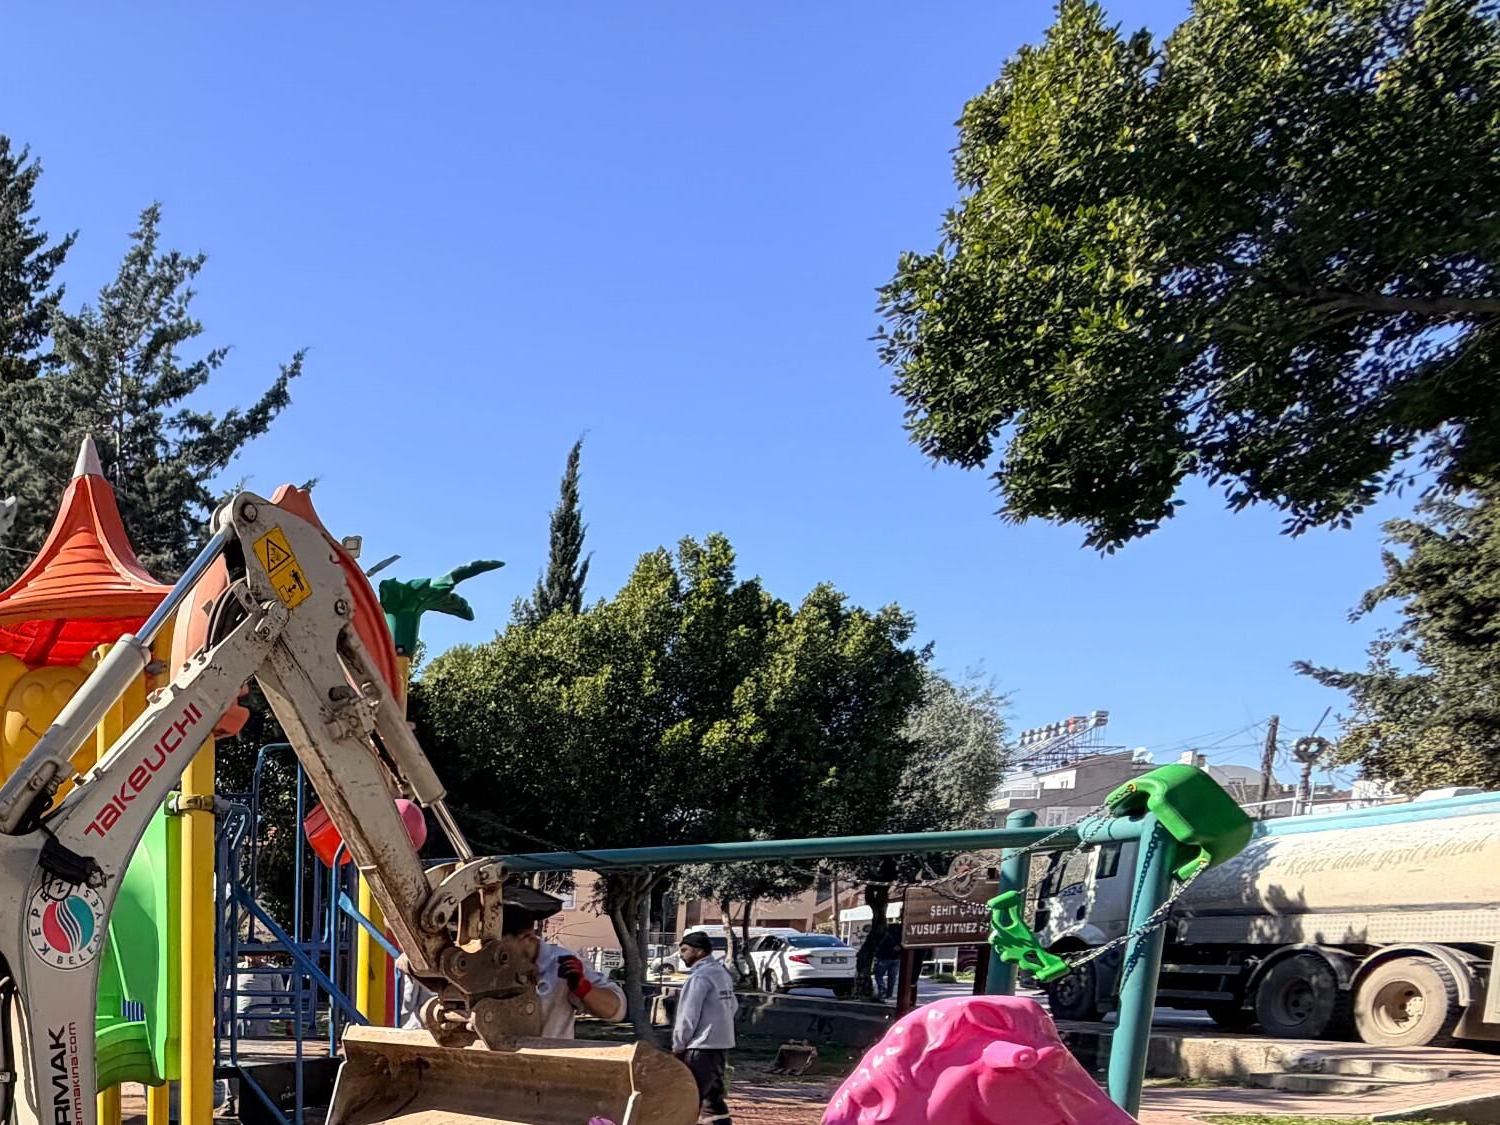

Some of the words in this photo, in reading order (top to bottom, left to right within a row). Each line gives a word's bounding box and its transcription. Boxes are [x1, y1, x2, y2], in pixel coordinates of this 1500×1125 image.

[1331, 848, 1376, 870] daha
[1422, 833, 1494, 860] olacak
[910, 923, 941, 935] YUSUF
